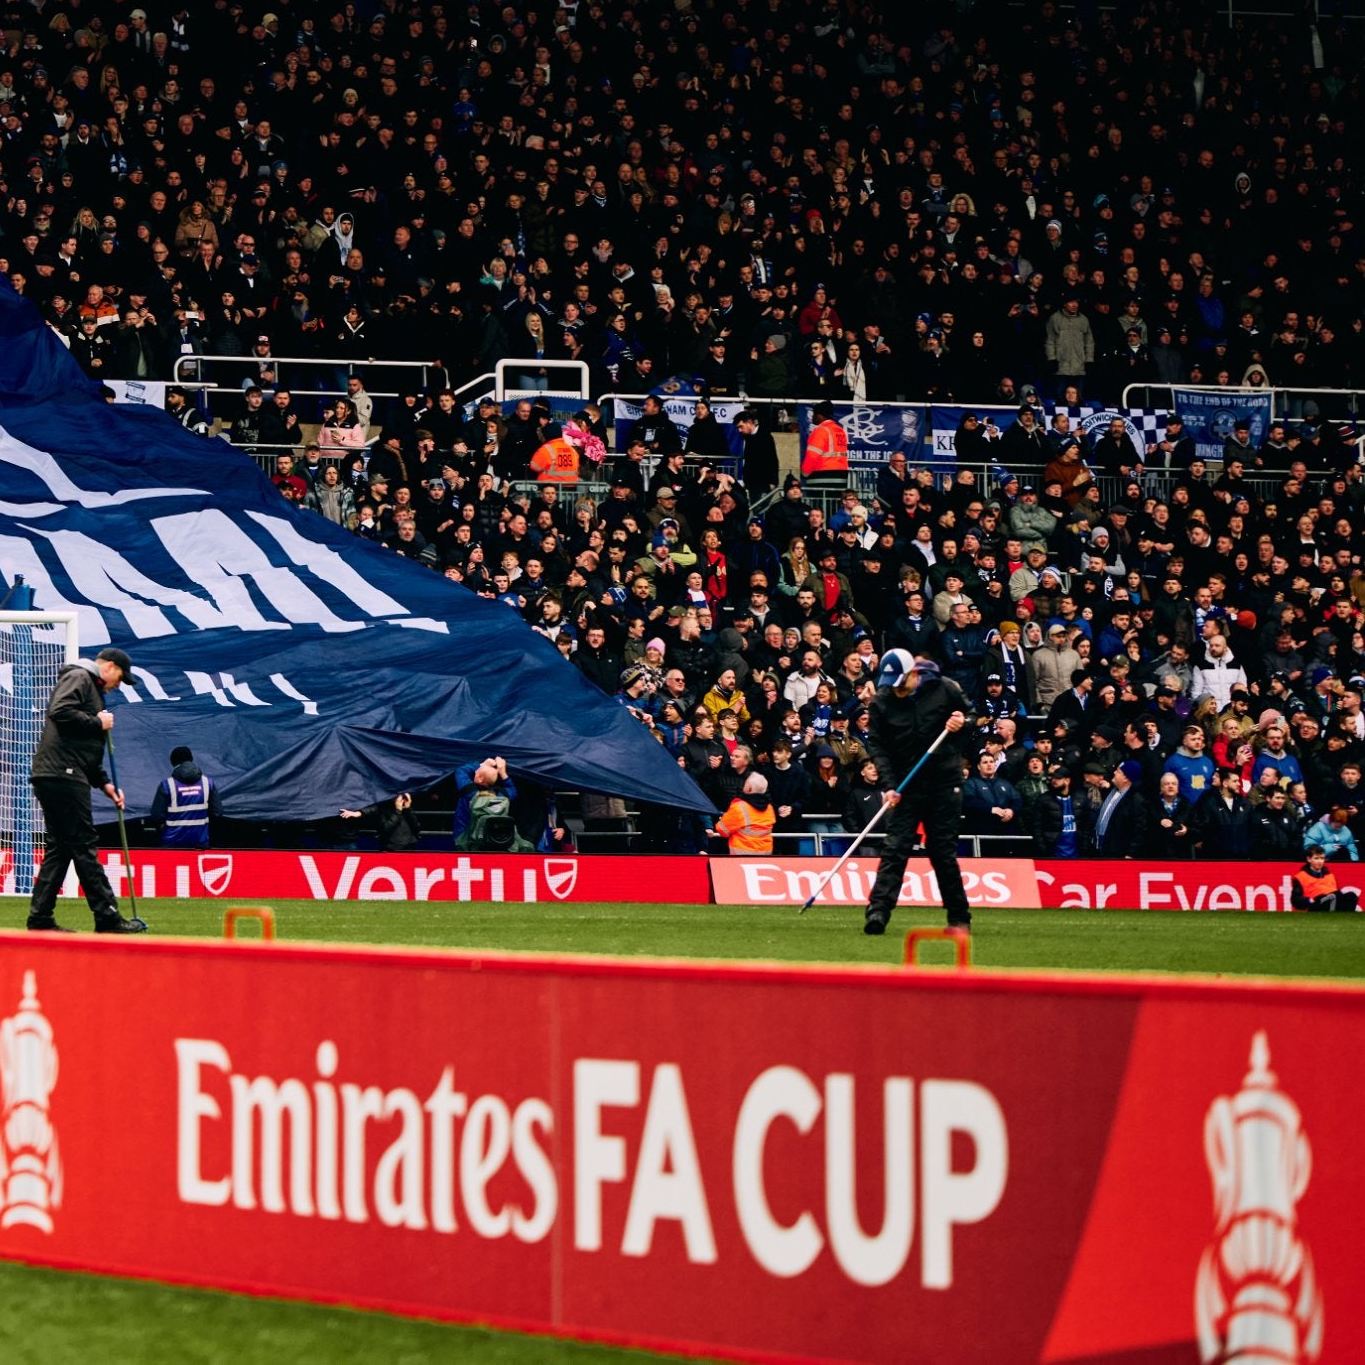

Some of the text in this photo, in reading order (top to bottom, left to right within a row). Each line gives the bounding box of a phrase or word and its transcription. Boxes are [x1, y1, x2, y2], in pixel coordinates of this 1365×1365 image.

[298, 854, 537, 902] Vertu
[740, 862, 1012, 904] Emiaes
[174, 1037, 1010, 1291] Emirates FA CUP
